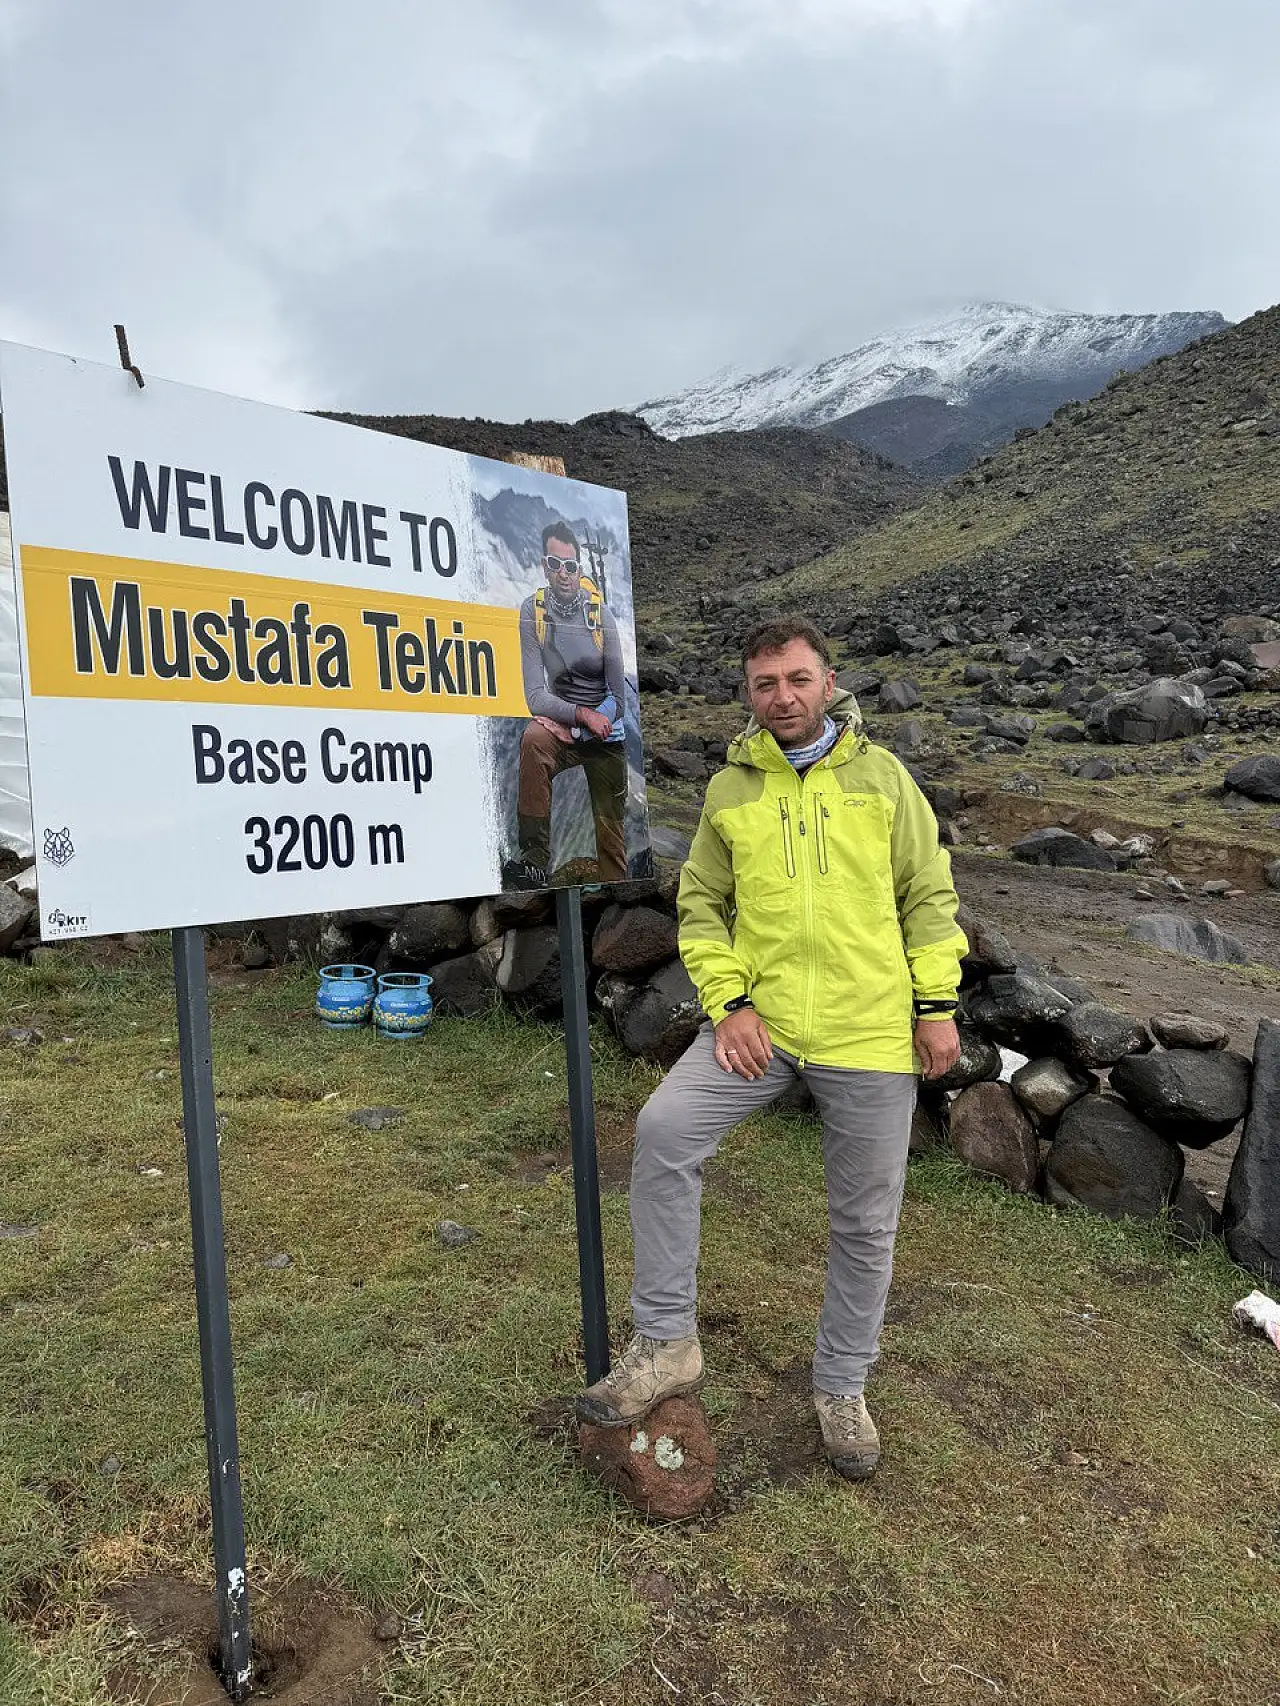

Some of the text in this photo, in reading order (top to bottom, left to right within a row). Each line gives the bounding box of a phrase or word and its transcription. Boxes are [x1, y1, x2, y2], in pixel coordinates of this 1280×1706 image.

[108, 456, 456, 577] WELCOME TO
[70, 576, 497, 698] Mustafa Tekin
[192, 725, 432, 793] Base Camp
[245, 814, 404, 874] 3200 m
